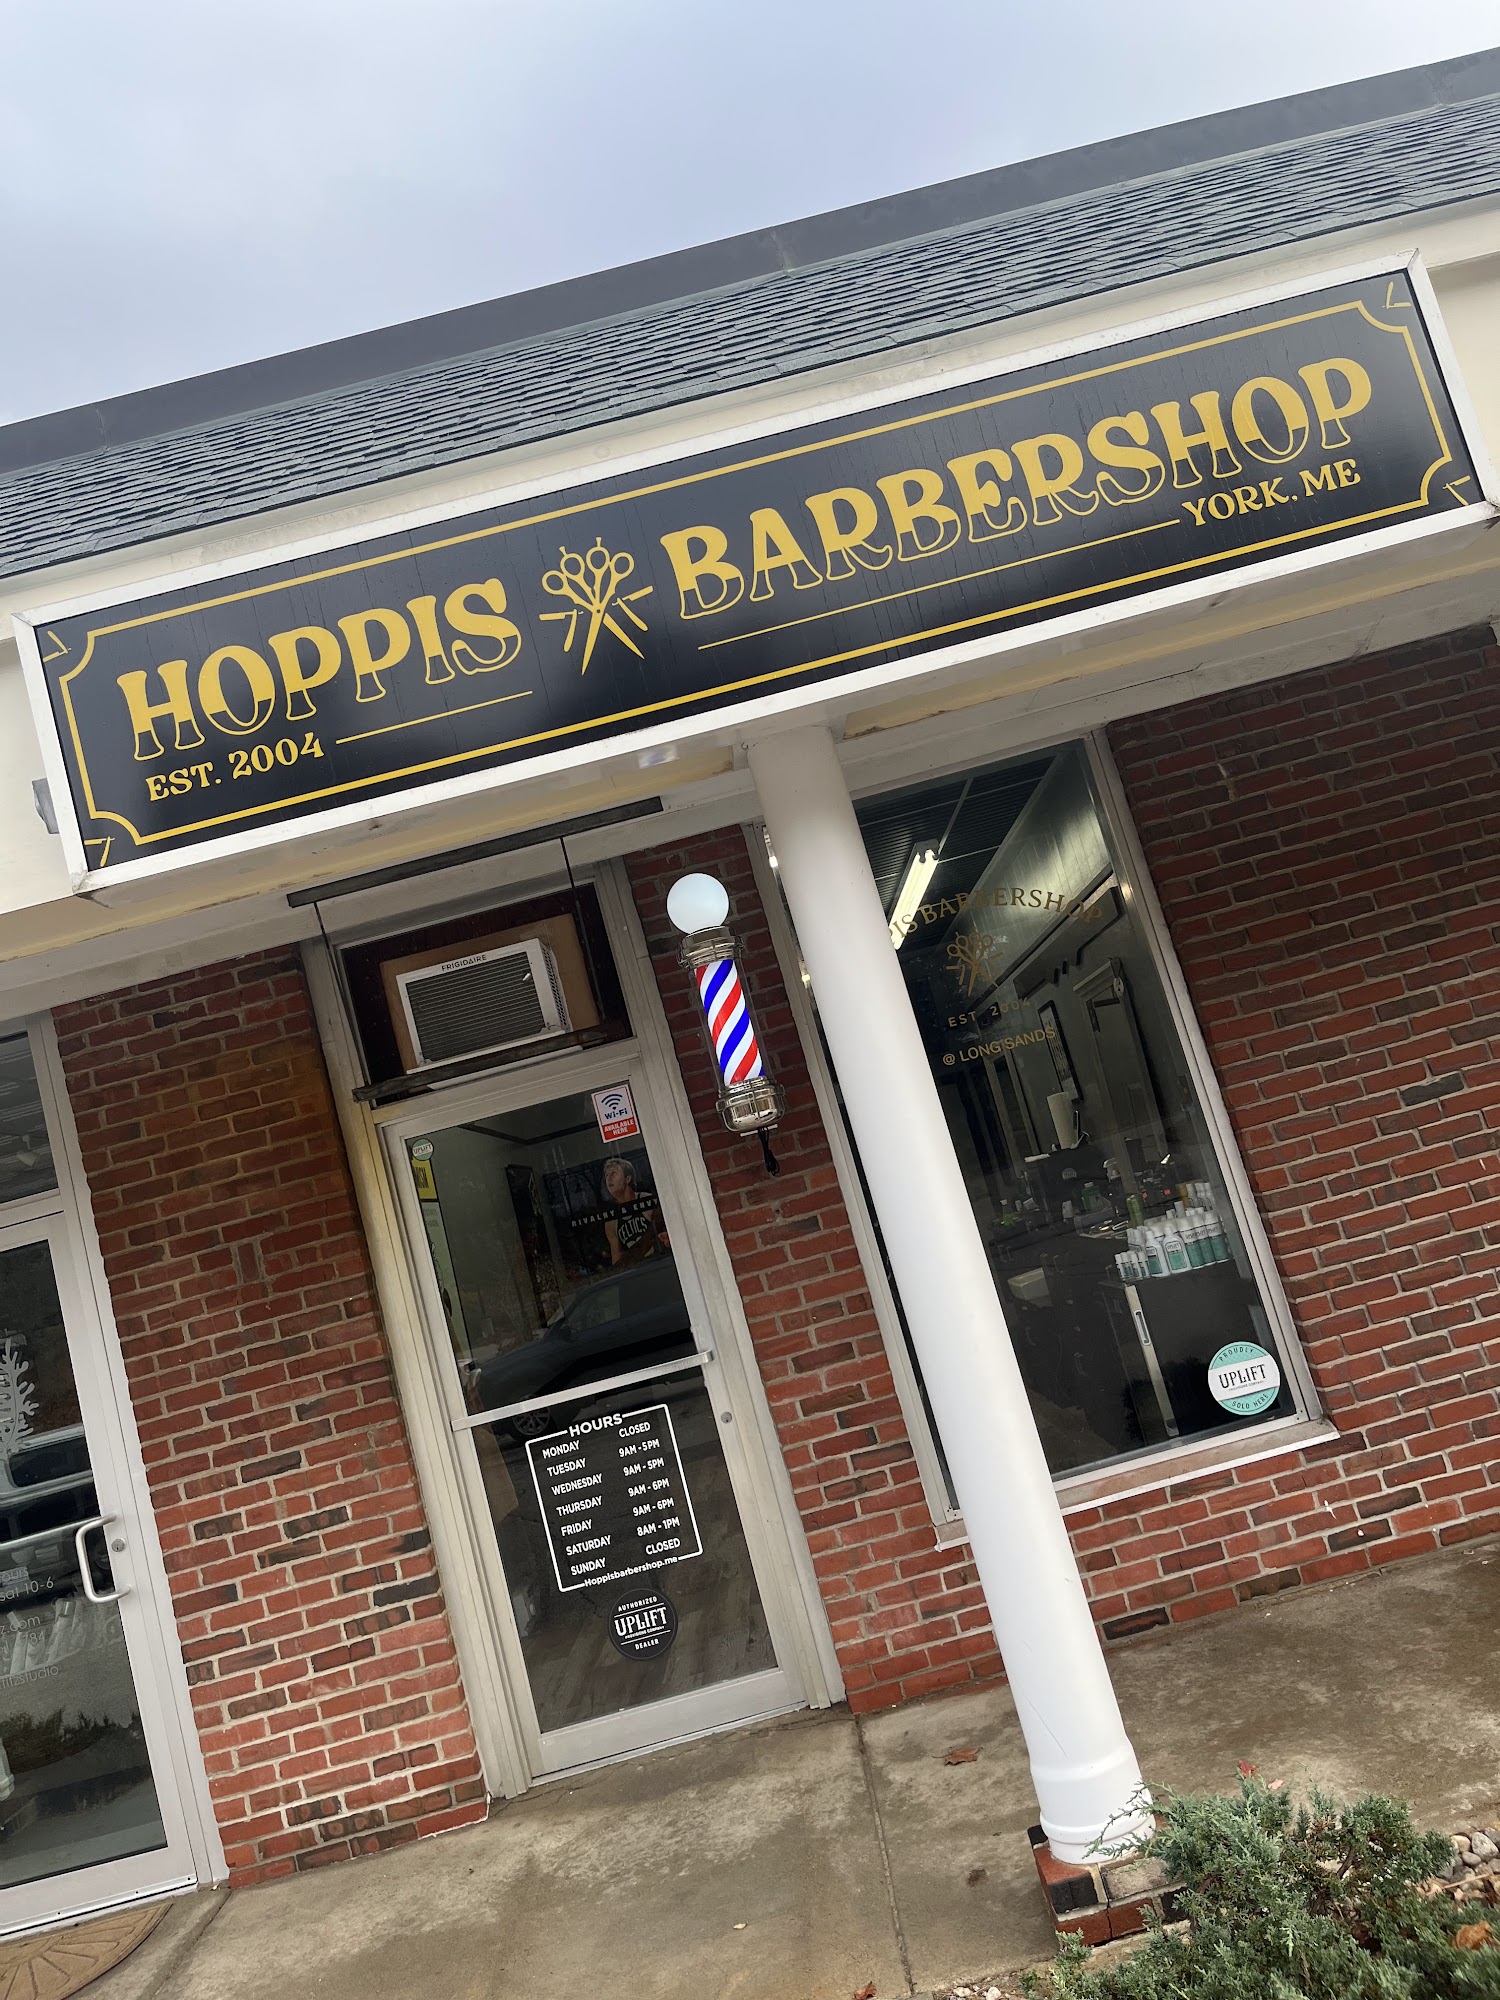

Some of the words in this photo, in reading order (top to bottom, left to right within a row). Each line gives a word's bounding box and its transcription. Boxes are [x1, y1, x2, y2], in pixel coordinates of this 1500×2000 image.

[1299, 458, 1361, 497] ME
[116, 578, 522, 762] HOPPIS
[660, 356, 1372, 620] BARBERSHOP
[145, 762, 222, 802] EST.
[228, 731, 325, 780] 2004
[917, 887, 1103, 925] BARBERSHOP
[441, 954, 487, 972] FRIGIDAIRE
[947, 1011, 977, 1028] EST
[990, 997, 1031, 1017] 2004
[942, 1052, 956, 1066] @
[959, 1041, 1002, 1062] LONG
[1004, 1026, 1056, 1051] SANDS
[604, 1120, 634, 1132] AVAILABLE
[613, 1127, 628, 1136] HERE
[571, 1209, 616, 1228] RIVALRY
[621, 1206, 627, 1214] &
[633, 1198, 658, 1212] ENVY
[618, 1216, 648, 1245] CELTICS
[1219, 1346, 1254, 1362] PROUDLY
[1218, 1363, 1266, 1389] UPLIFT
[1231, 1400, 1250, 1410] SOLD
[1253, 1393, 1269, 1408] HERE
[542, 1440, 580, 1459] MONDAY
[618, 1421, 651, 1438] CLOSED
[569, 1413, 623, 1437] HOURS
[547, 1458, 586, 1477] TUESDAY
[618, 1444, 638, 1458] 9AM
[551, 1473, 603, 1496] WEDNESDAY
[623, 1463, 642, 1477] 9AM
[647, 1457, 665, 1471] 5PM
[556, 1495, 602, 1517] THURSDAY
[628, 1484, 647, 1498] 9AM
[652, 1478, 670, 1491] 6PM
[560, 1519, 593, 1537] FRIDAY
[632, 1504, 651, 1517] 9AM
[656, 1497, 675, 1511] 6PM
[566, 1535, 611, 1556] SATURDAY
[636, 1523, 656, 1537] 8AM
[662, 1516, 680, 1530] 1PM
[570, 1557, 607, 1576] SUNDAY
[645, 1537, 681, 1555] CLOSED
[584, 1555, 678, 1587] Hoppisbarbershop.me
[24, 1576, 54, 1595] 10-6
[618, 1596, 658, 1612] AUTHORIZED
[614, 1606, 667, 1637] UPLIFT
[634, 1638, 660, 1650] DEALER
